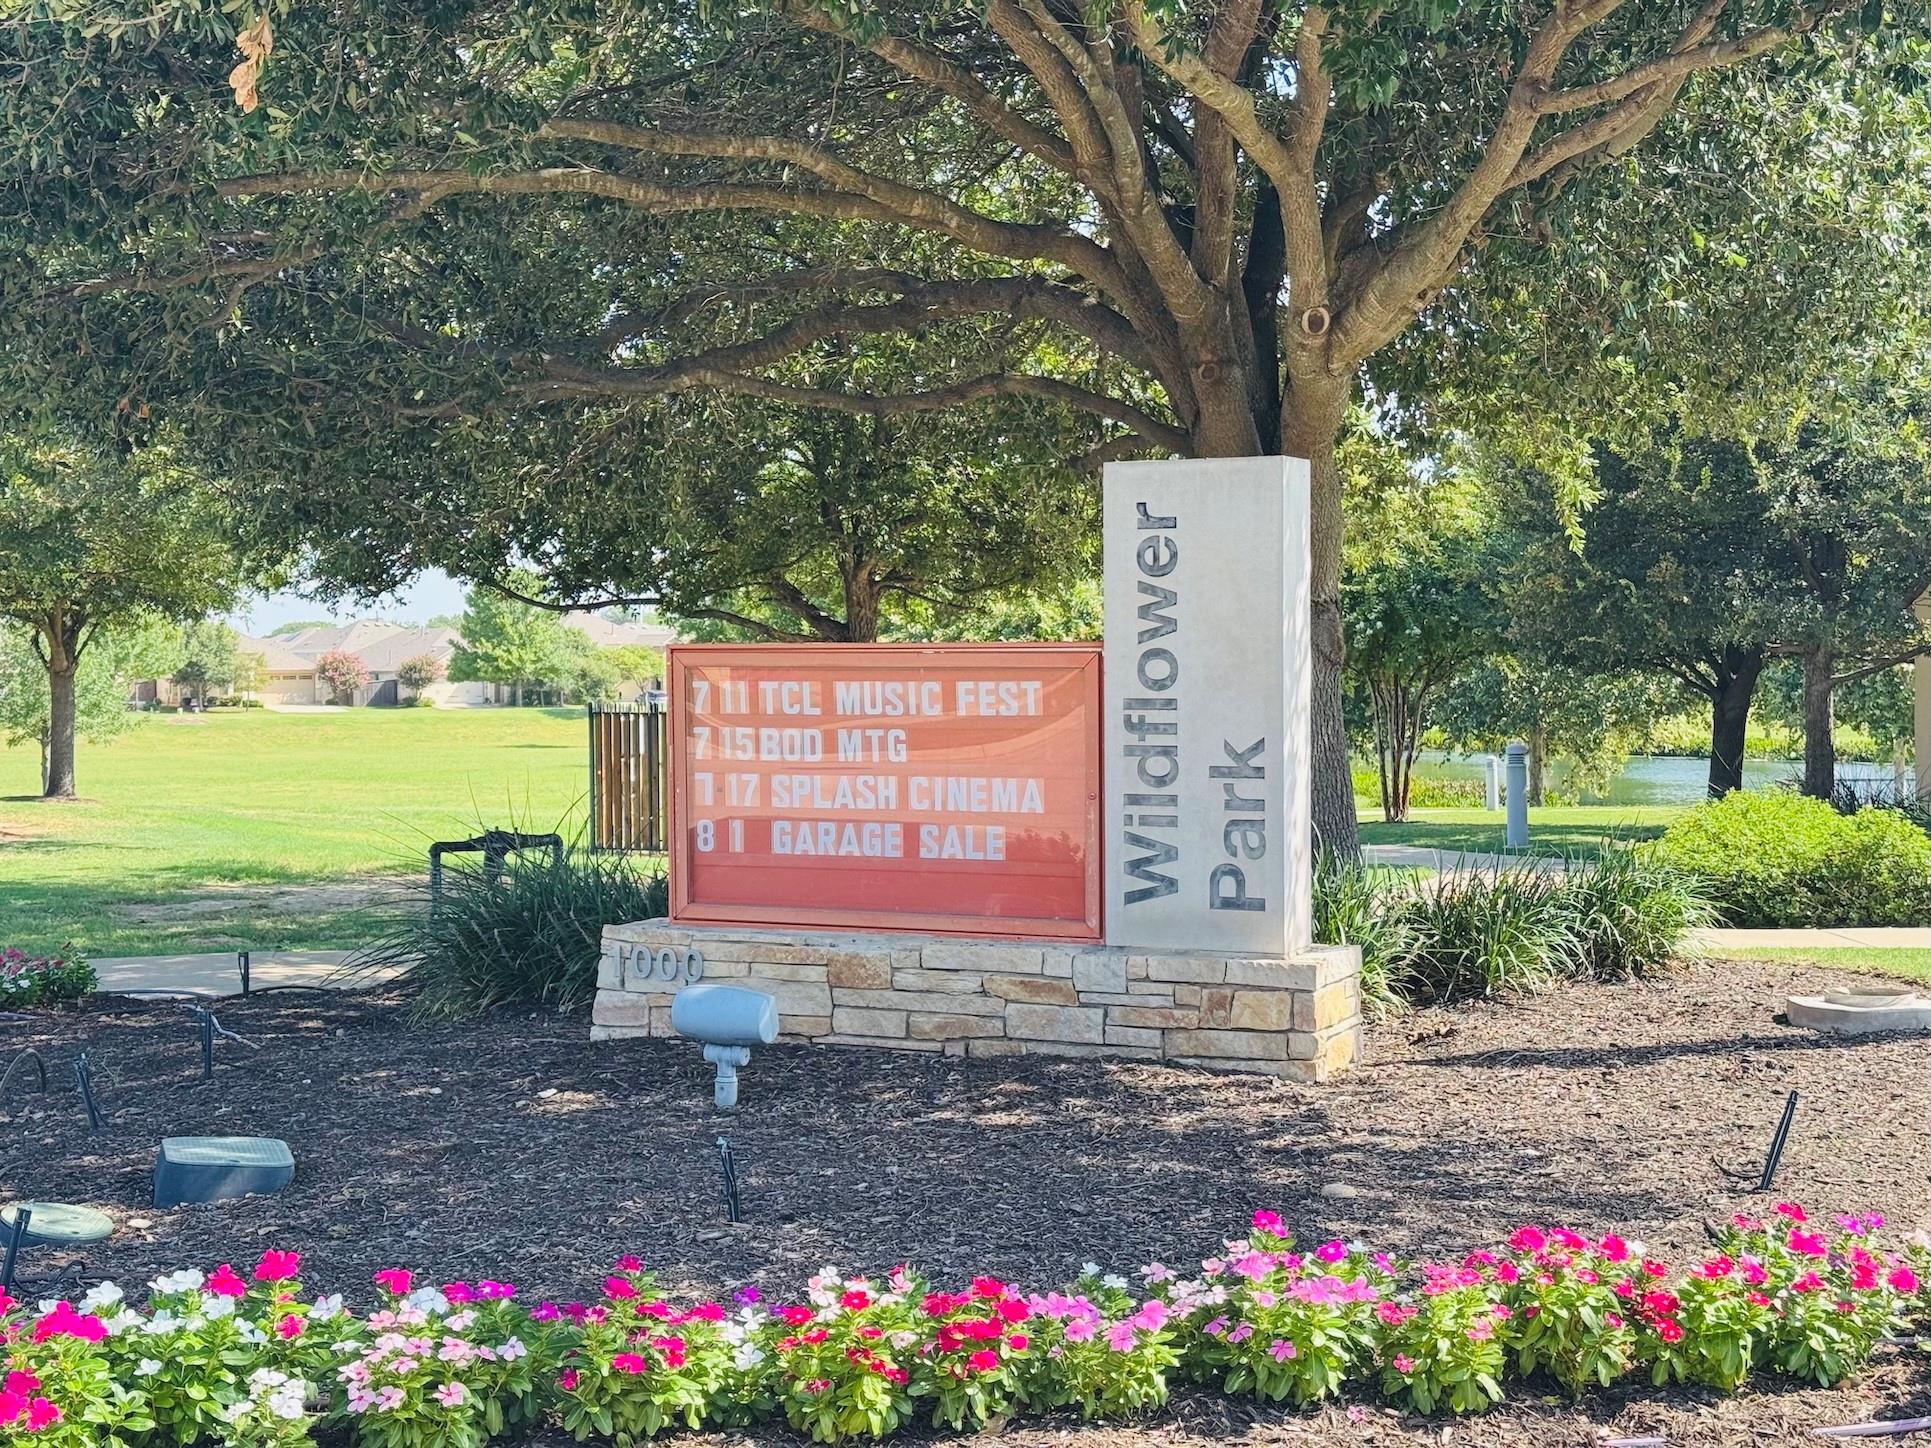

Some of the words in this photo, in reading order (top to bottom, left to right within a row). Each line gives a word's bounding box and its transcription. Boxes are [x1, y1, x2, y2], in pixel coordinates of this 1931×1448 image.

[692, 681, 708, 714] 7
[759, 681, 821, 715] TCL
[835, 681, 941, 716] MUSIC
[957, 681, 1041, 716] FEST
[1122, 501, 1180, 906] Wildflower
[692, 727, 709, 760] 7
[760, 728, 822, 762] BOD
[838, 729, 907, 763] MTG
[771, 775, 896, 809] SPLASH
[909, 777, 1044, 814] CINEMA
[696, 819, 715, 852] 8
[729, 821, 744, 853] 1
[773, 822, 901, 857] GARAGE
[920, 824, 1003, 860] SALE
[1209, 737, 1266, 913] Park
[613, 944, 704, 983] 1000
